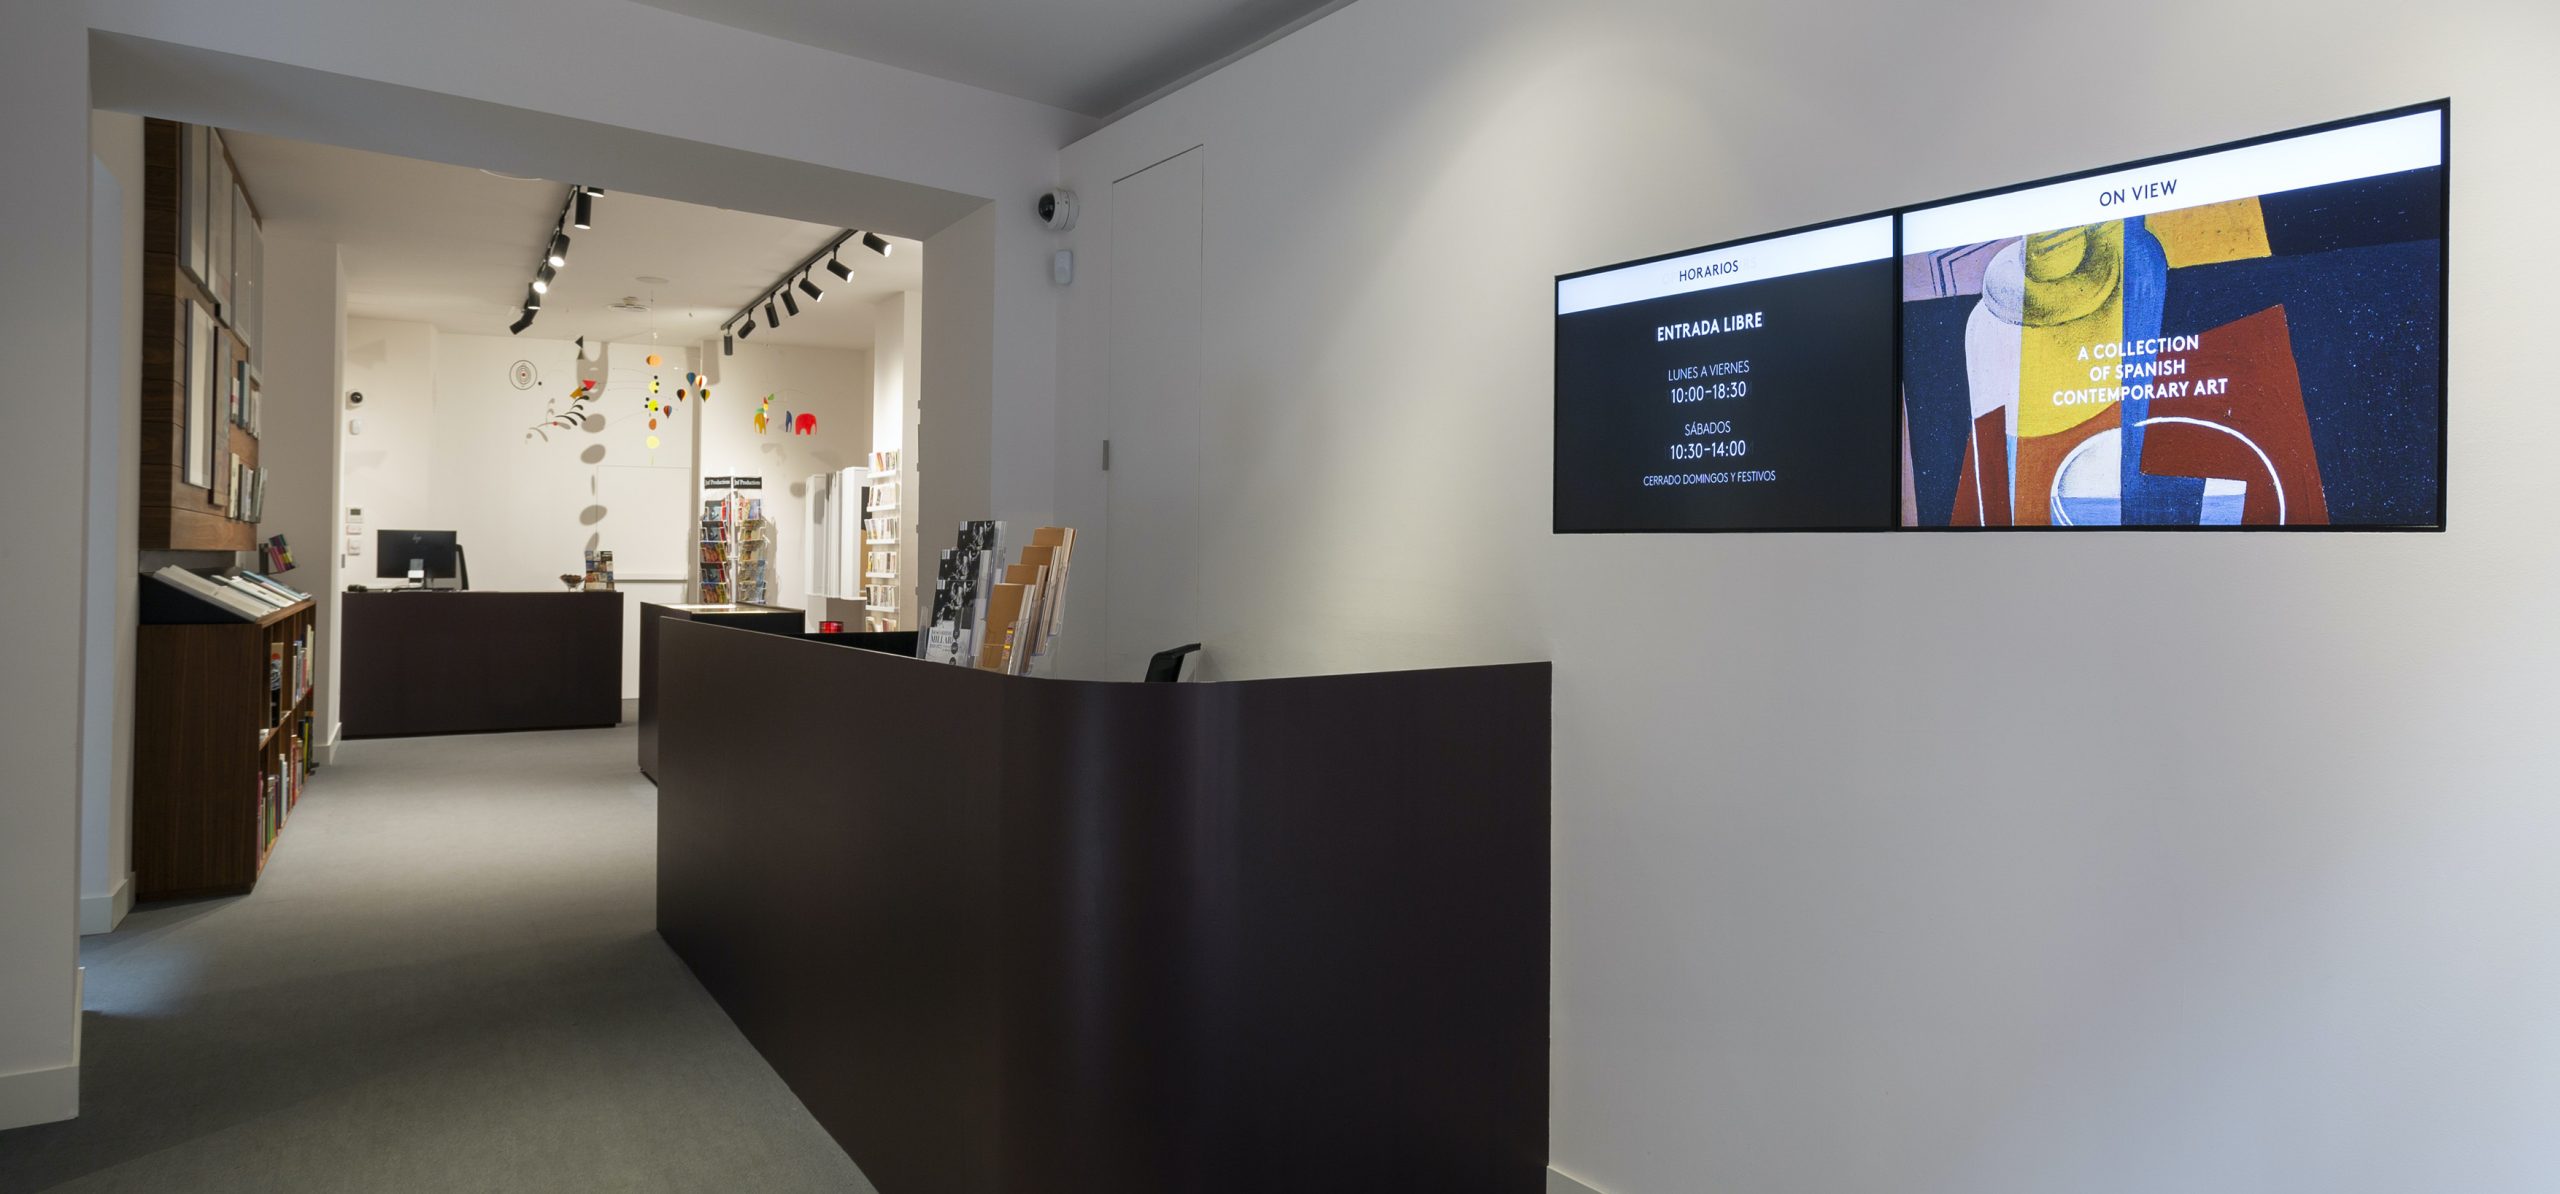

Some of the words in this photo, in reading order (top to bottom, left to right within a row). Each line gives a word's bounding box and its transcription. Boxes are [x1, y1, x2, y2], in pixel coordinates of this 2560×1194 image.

[2099, 188, 2125, 207] ON
[2131, 179, 2177, 200] VIEW
[1679, 259, 1740, 282] HORARIOS
[1657, 318, 1720, 342] ENTRADA
[1723, 312, 1763, 333] LIBRE
[2077, 346, 2089, 361] A
[2093, 335, 2199, 360] COLLECTION
[1668, 366, 1699, 382] LUNES
[1700, 365, 1708, 378] A
[1709, 360, 1750, 376] VIERNES
[2089, 365, 2111, 382] OF
[2115, 359, 2186, 380] SPANISH
[2052, 381, 2190, 406] CONTEMPORARY
[2193, 378, 2229, 396] ART
[1684, 421, 1731, 437] SÁBADOS
[1643, 474, 1681, 486] CERRADO
[1682, 472, 1729, 485] DOMINGOS
[1730, 472, 1737, 483] Y
[1737, 470, 1776, 483] FESTIVOS
